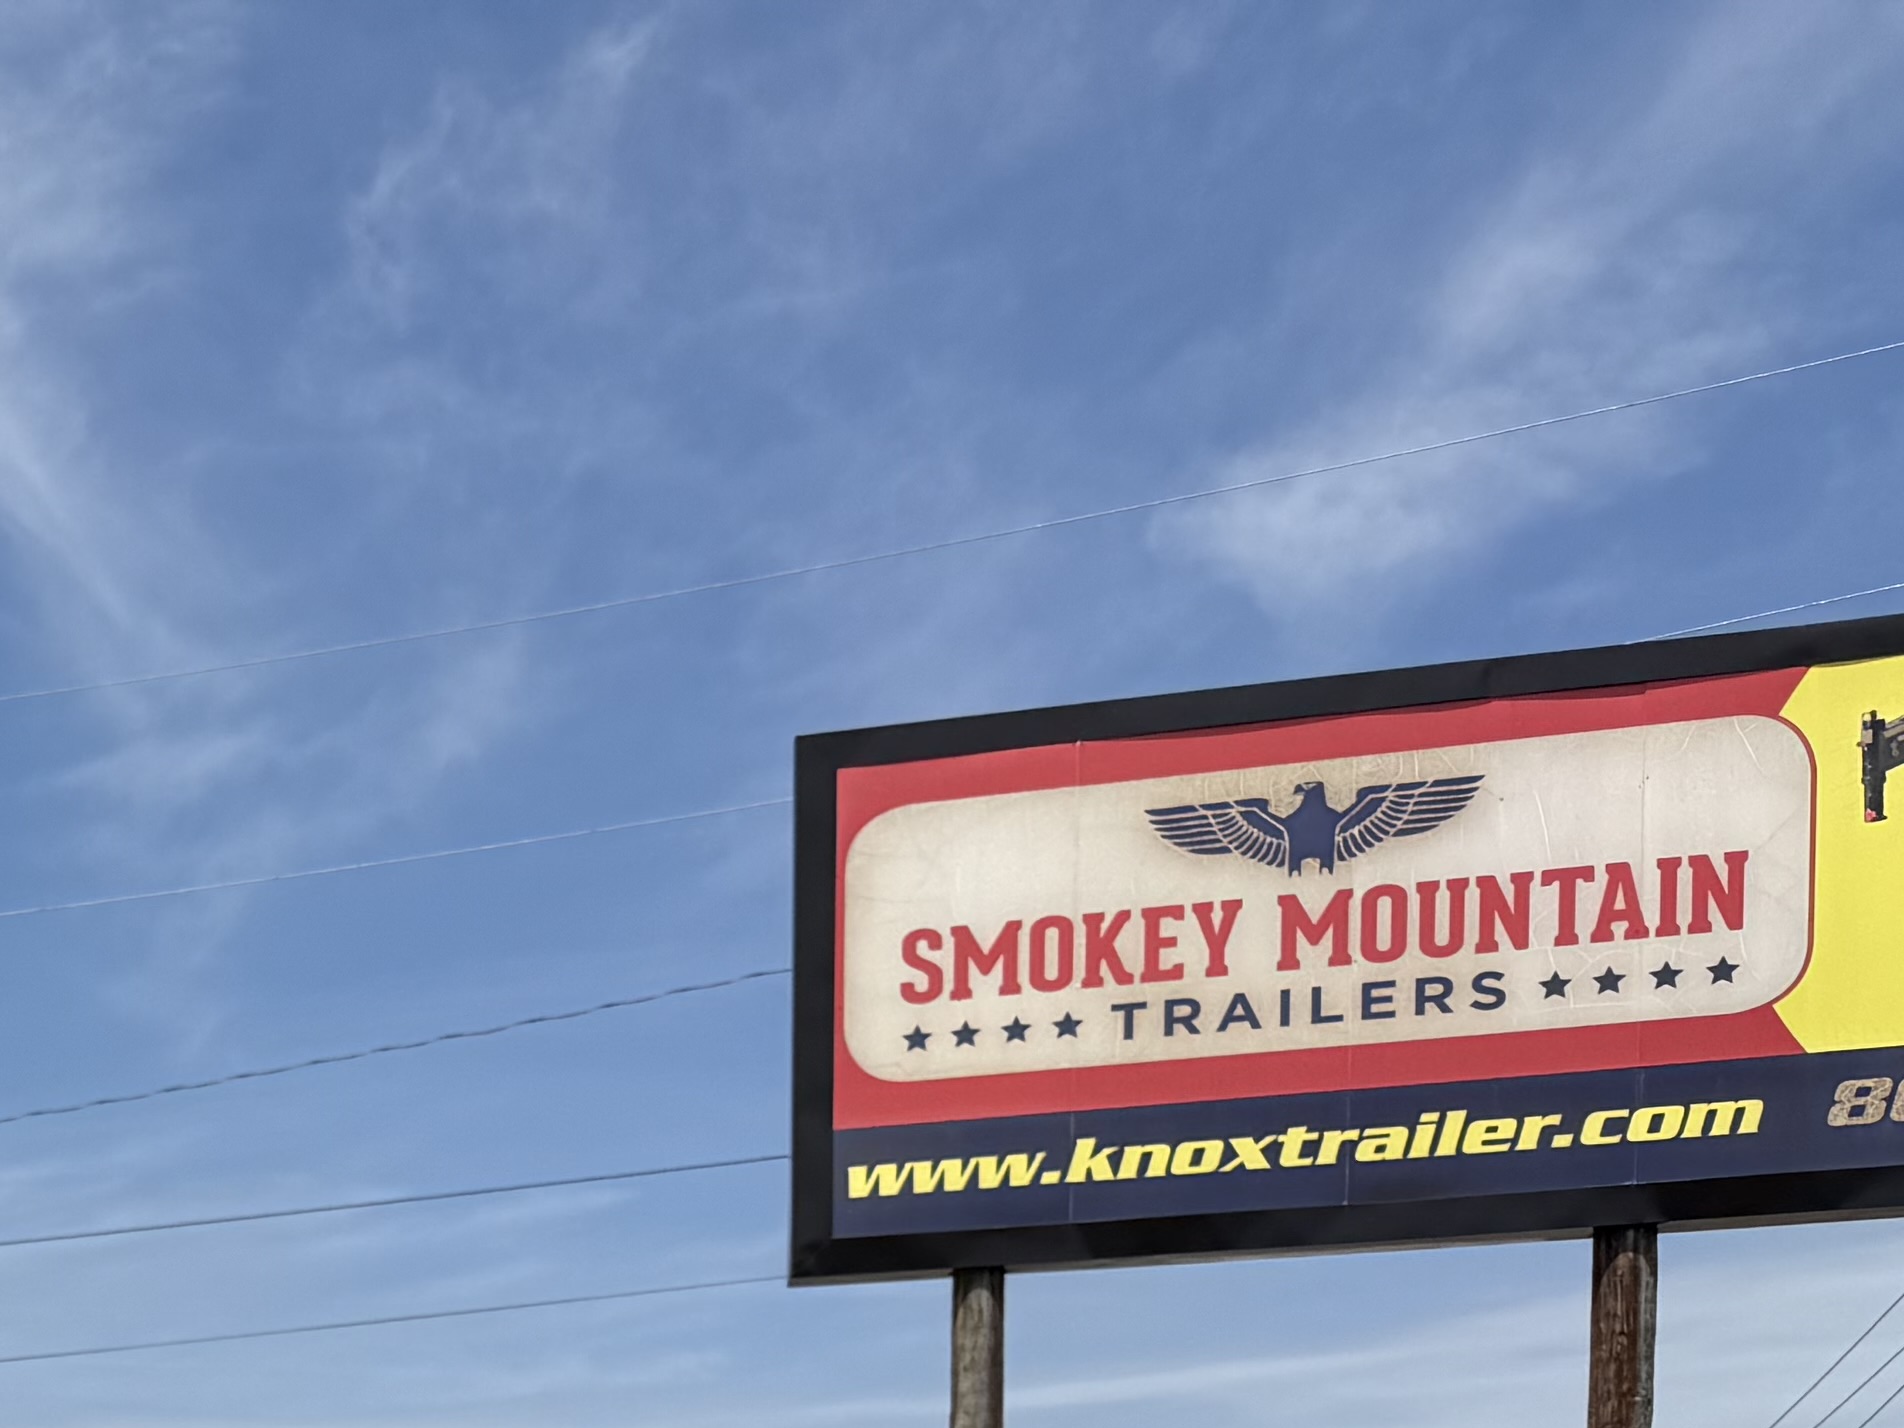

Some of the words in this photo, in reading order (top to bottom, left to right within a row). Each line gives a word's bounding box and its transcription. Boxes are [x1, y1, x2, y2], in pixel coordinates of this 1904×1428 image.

[899, 898, 1244, 1005] SMOKEY
[1275, 850, 1750, 972] MOUNTAIN
[1109, 970, 1508, 1041] TRAILERS
[1827, 1077, 1904, 1127] 8
[846, 1097, 1765, 1199] www.knoxtrailer.com
